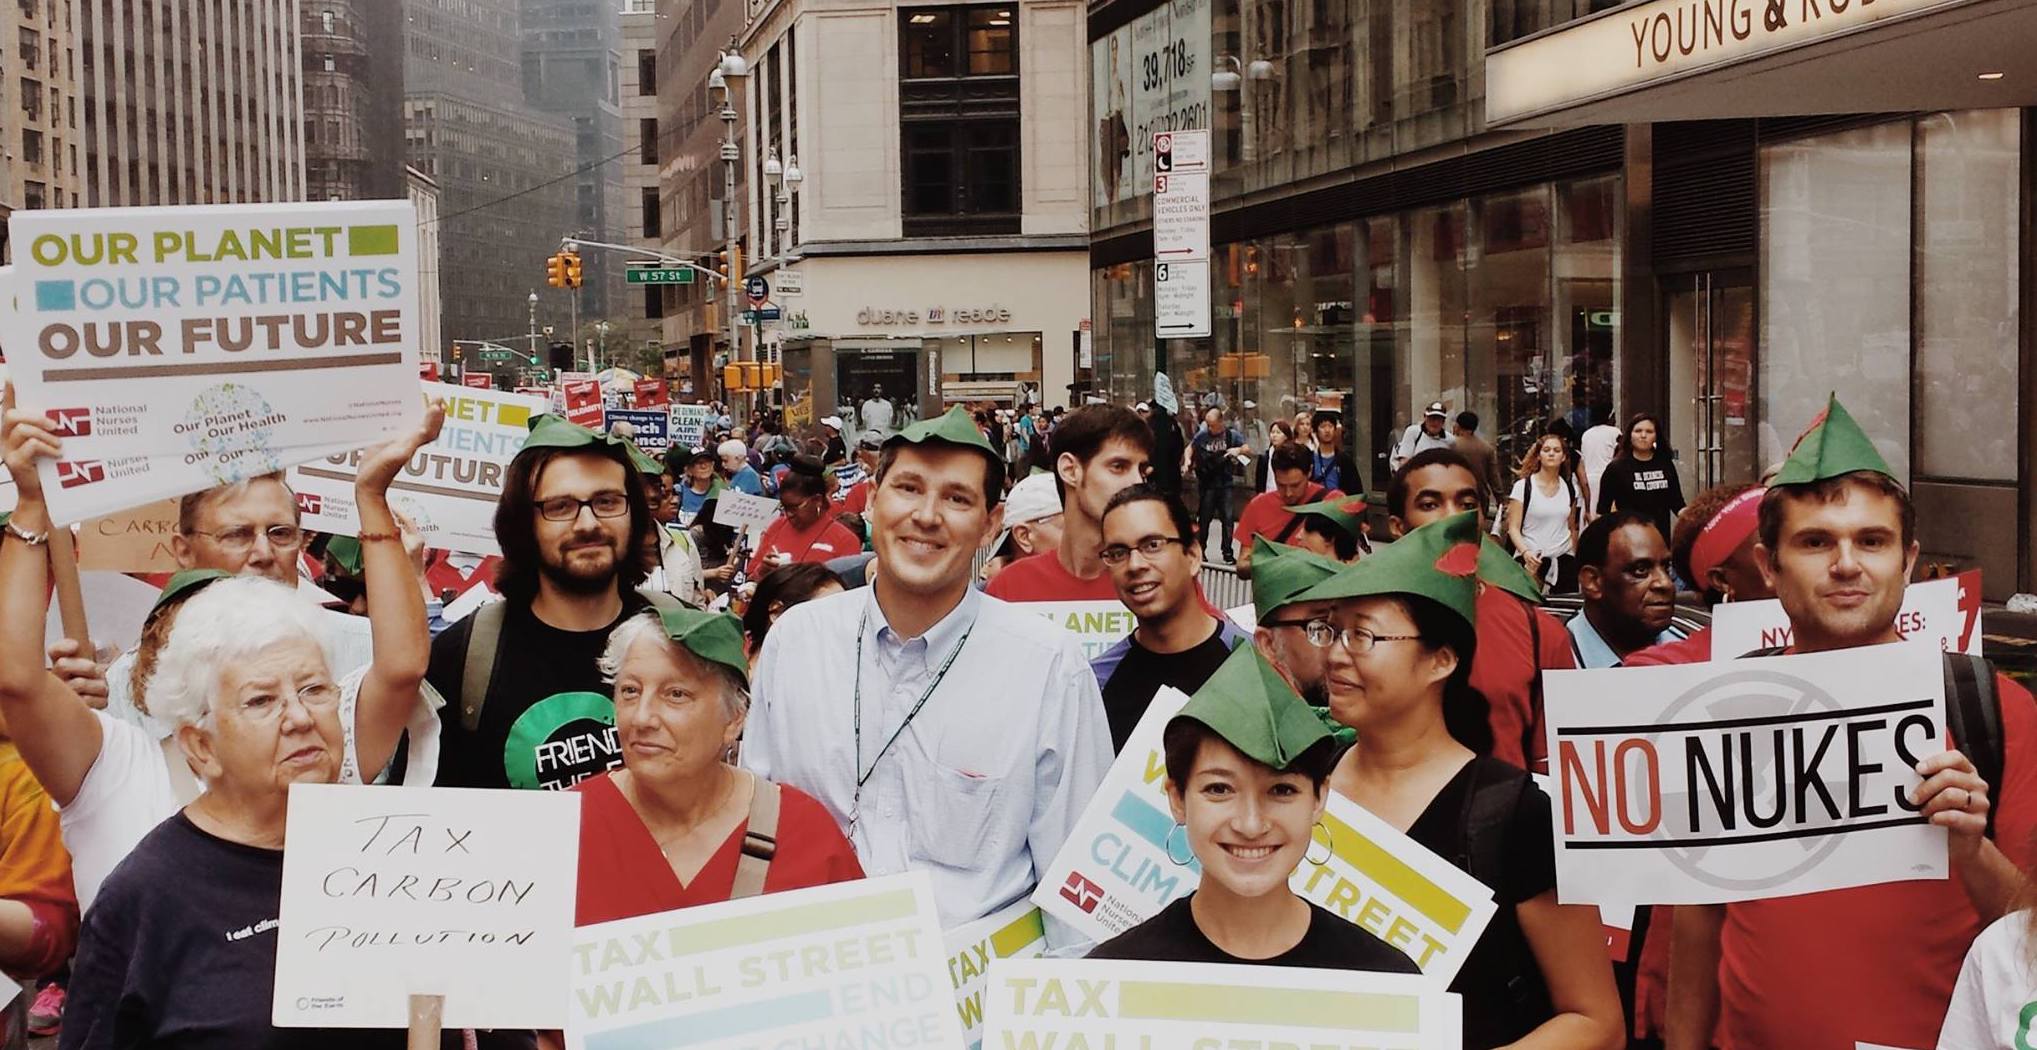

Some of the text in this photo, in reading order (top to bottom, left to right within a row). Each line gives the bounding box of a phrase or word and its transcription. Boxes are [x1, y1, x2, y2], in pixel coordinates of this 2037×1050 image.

[1630, 0, 1751, 68] YOUNG
[1143, 38, 1186, 92] 39,718
[1157, 176, 1167, 193] 3
[31, 227, 343, 266] OUR PLANET
[639, 271, 681, 281] W 57 St
[1157, 264, 1168, 281] 6
[79, 268, 401, 311] OUR PATIENTS
[857, 305, 919, 325] duane
[952, 303, 1012, 324] reade
[38, 309, 402, 359] OUR FUTURE
[95, 404, 148, 415] National
[96, 415, 138, 426] Nurses
[173, 409, 253, 434] Our Planet
[97, 425, 138, 437] United
[207, 413, 287, 438] Our Health
[110, 463, 151, 479] United
[323, 503, 348, 513] Nurses
[324, 496, 355, 507] National
[322, 510, 348, 520] United
[1894, 612, 1926, 634] ES:
[1557, 713, 1937, 836] NO NUKES
[354, 813, 472, 856] TAX
[1090, 832, 1180, 906] CLIM
[323, 866, 535, 905] CARBON
[1289, 858, 1449, 970] TREET
[232, 925, 254, 940] eat
[305, 926, 535, 952] POLLUTION
[573, 930, 665, 977] TAX
[575, 928, 923, 1019] WALL STREET
[838, 973, 934, 1018] END
[1003, 978, 1111, 1019] TAX
